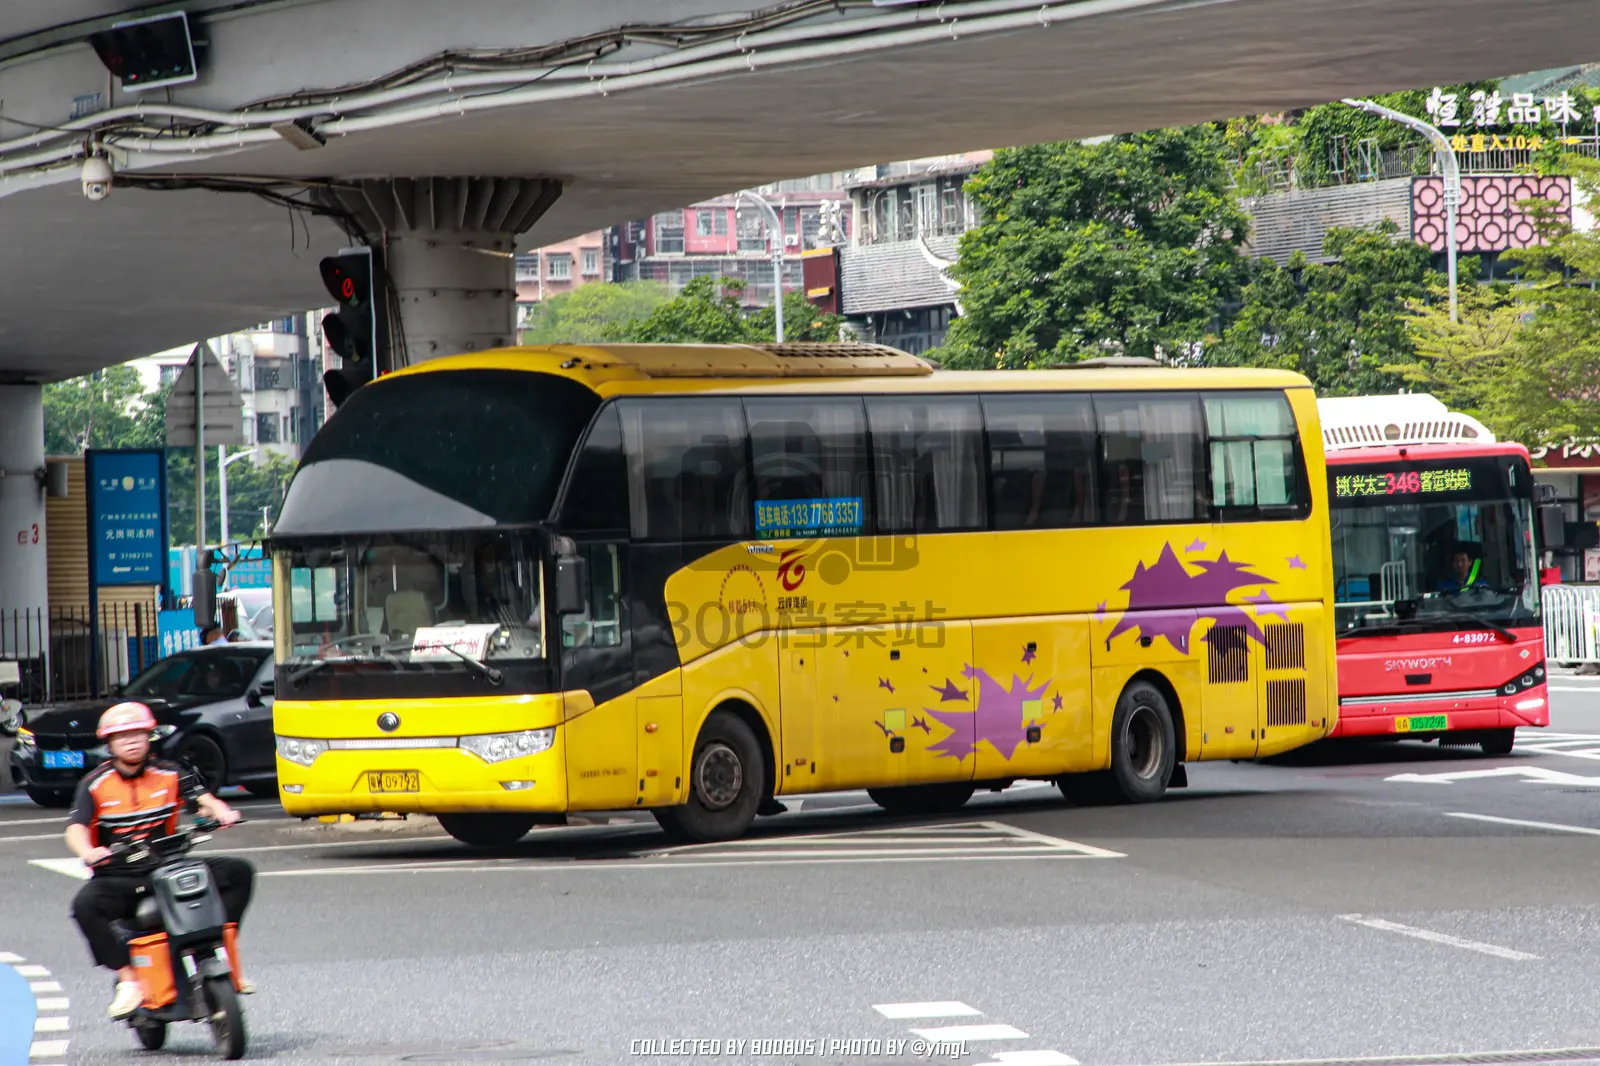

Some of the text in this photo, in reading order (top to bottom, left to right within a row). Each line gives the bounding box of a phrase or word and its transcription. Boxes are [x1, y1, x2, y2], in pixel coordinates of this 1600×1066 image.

[1384, 471, 1420, 494] 346
[810, 502, 834, 525] 7766
[835, 501, 859, 523] 3357
[1453, 632, 1496, 644] 4-83072
[1385, 656, 1451, 671] SKYWORTH
